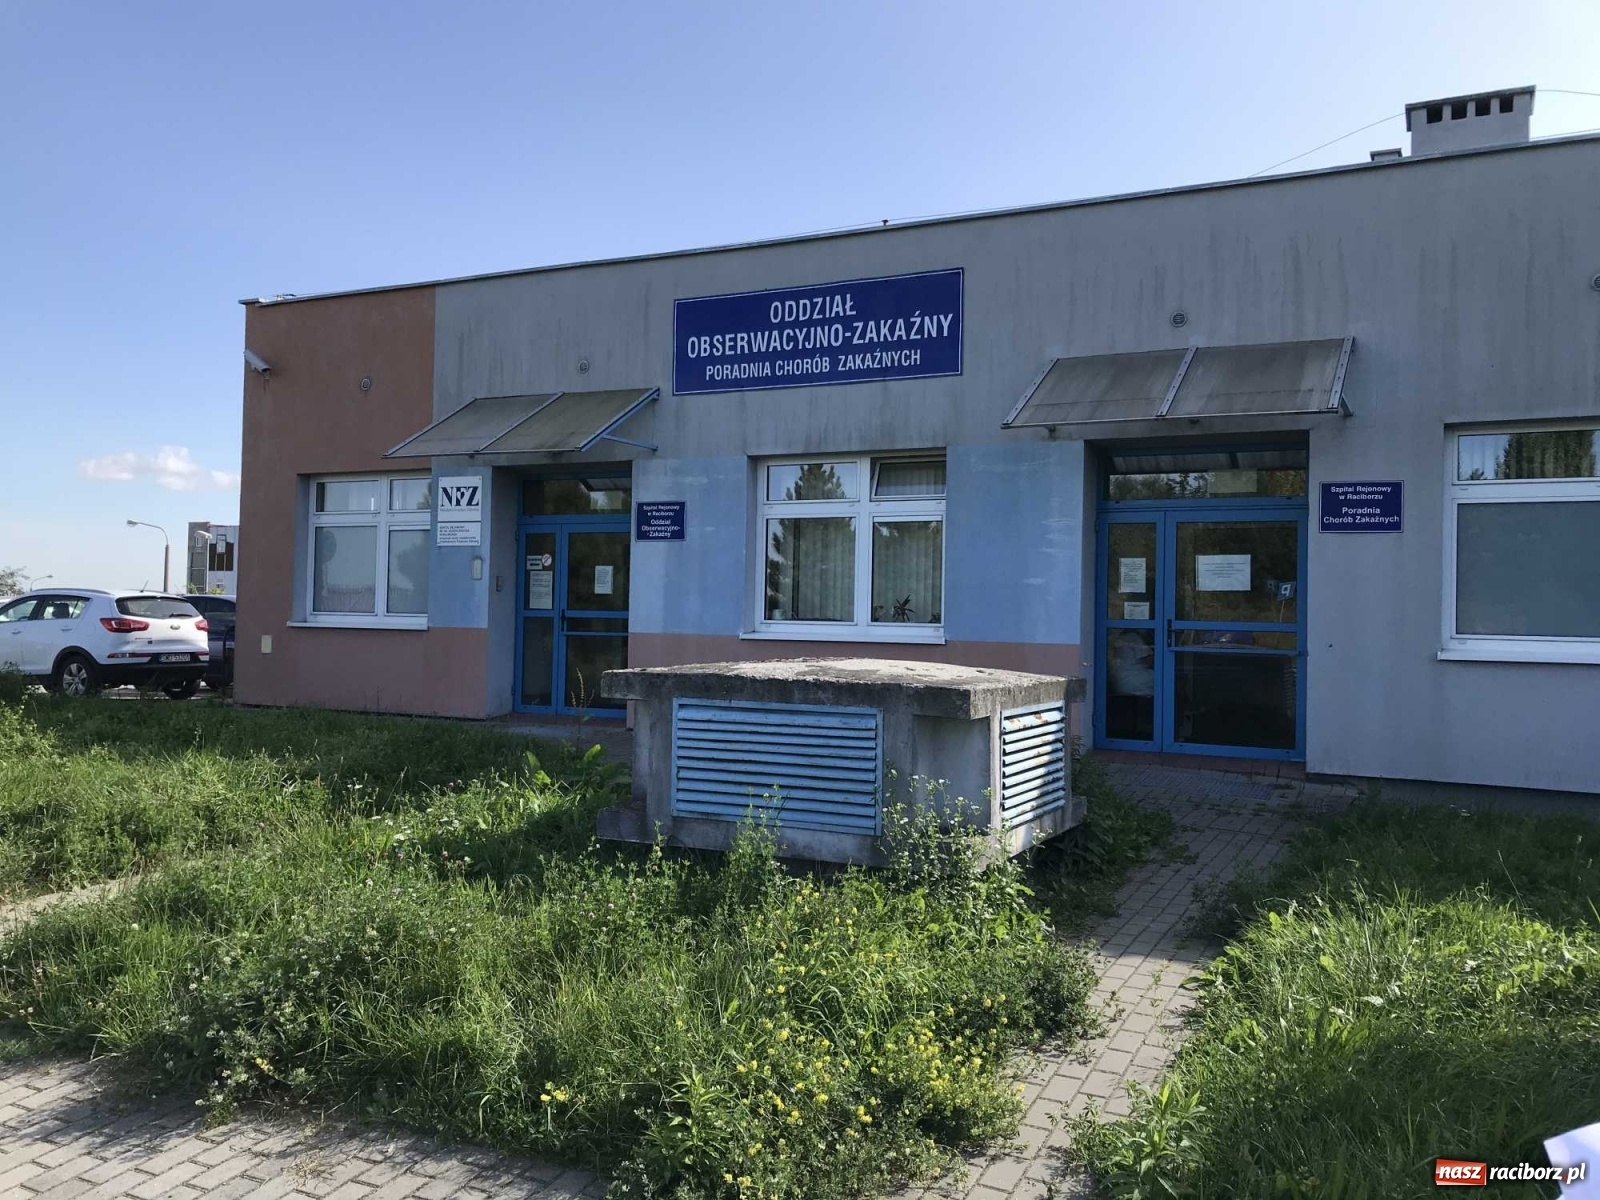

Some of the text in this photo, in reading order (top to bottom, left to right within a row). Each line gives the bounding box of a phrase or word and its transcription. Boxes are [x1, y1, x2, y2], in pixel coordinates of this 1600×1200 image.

[769, 294, 857, 323] ODDZIAŁ
[687, 311, 954, 358] OBSERWACYJNO-ZAKAŹNY
[705, 348, 921, 381] PORADNIA CHORÓB ZAKAŹNYCH
[440, 486, 480, 507] NFZ
[1330, 486, 1355, 494] Szpital
[1323, 516, 1354, 524] Chorób
